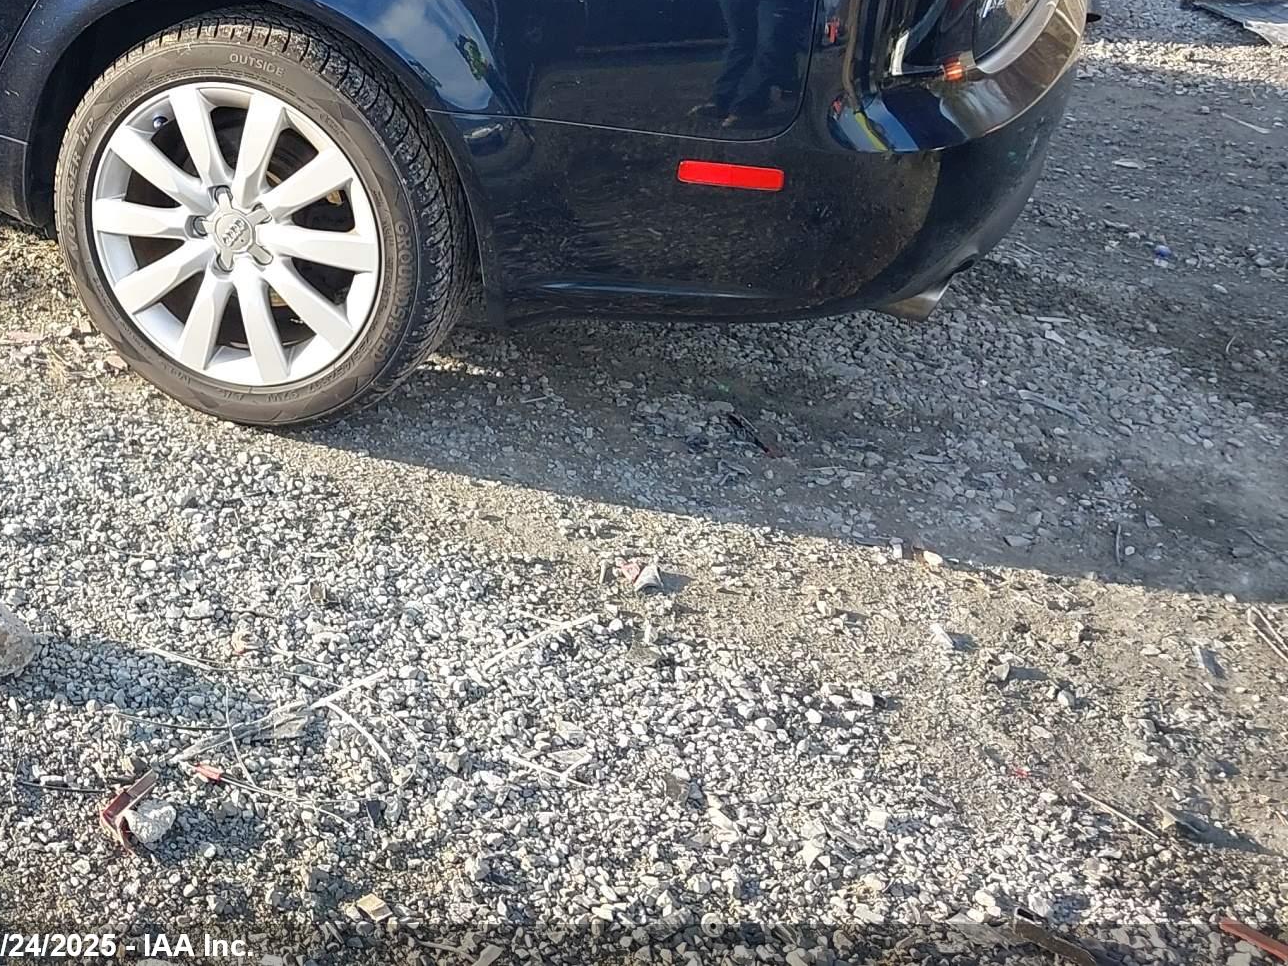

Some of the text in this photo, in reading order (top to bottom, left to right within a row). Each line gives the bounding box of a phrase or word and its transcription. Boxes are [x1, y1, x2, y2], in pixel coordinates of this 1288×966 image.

[228, 52, 287, 79] OUTSIDE
[64, 150, 83, 253] VOYAGER
[78, 116, 96, 147] HP
[372, 220, 416, 362] GROUNDSPEED
